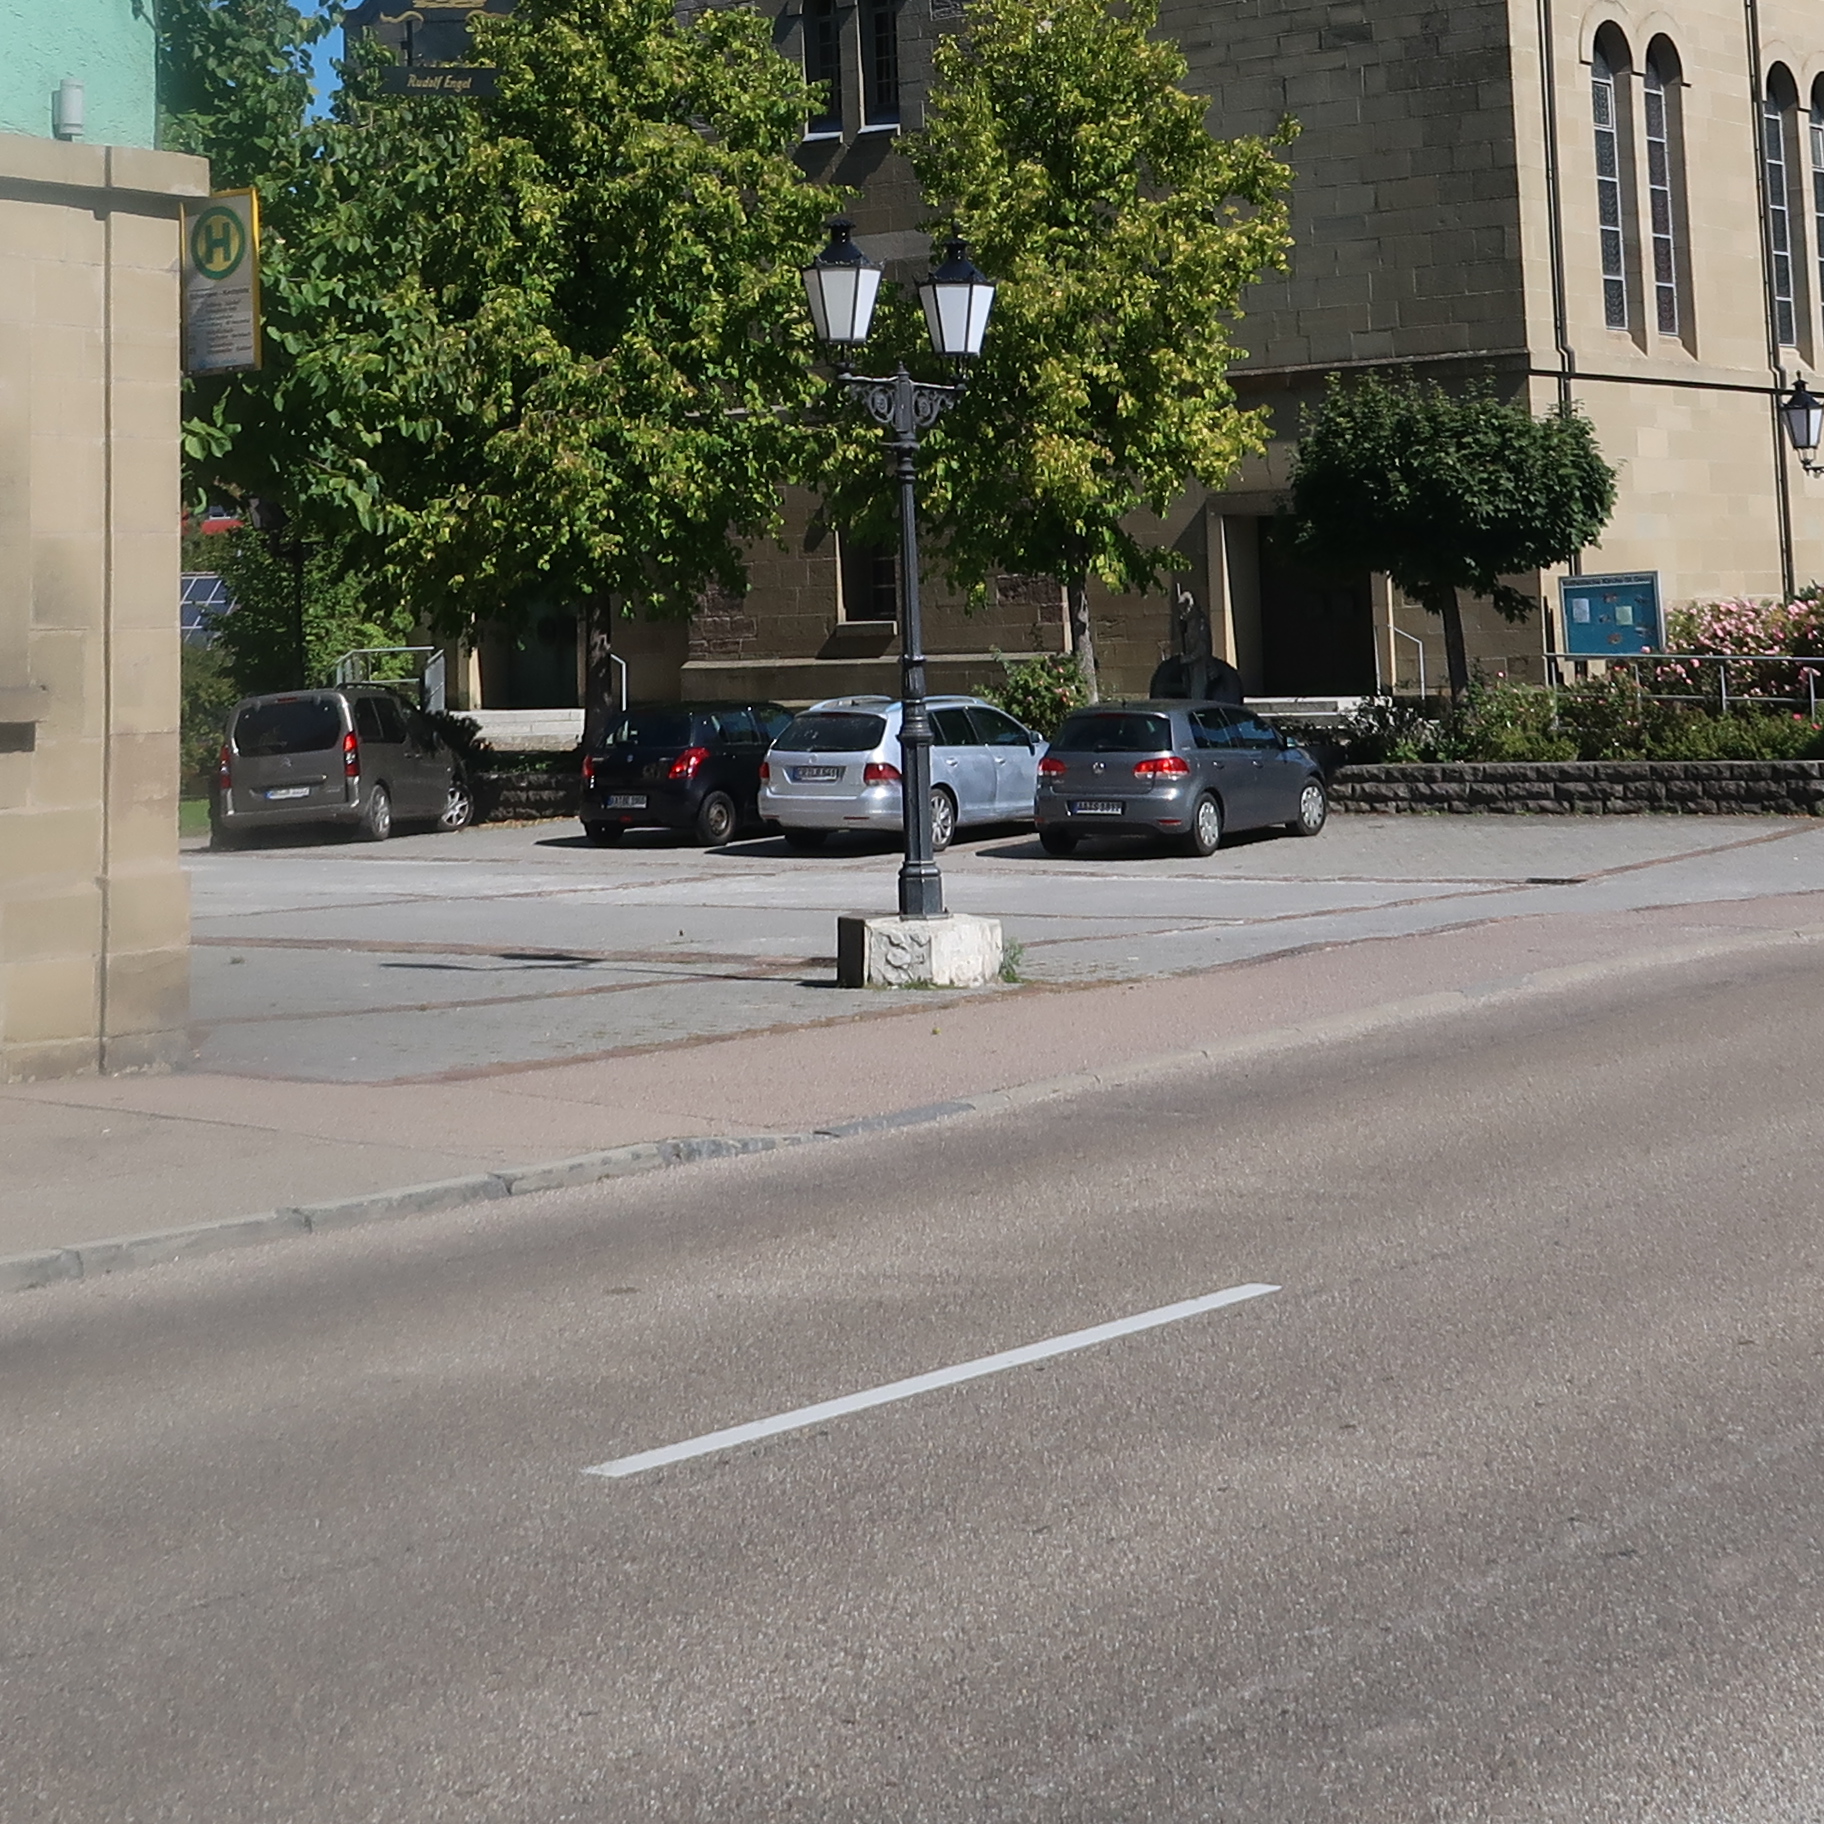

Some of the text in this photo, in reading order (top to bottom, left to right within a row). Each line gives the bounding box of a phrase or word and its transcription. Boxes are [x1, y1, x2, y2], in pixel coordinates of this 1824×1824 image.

[406, 74, 472, 93] Rudolf Engel
[205, 222, 232, 264] H
